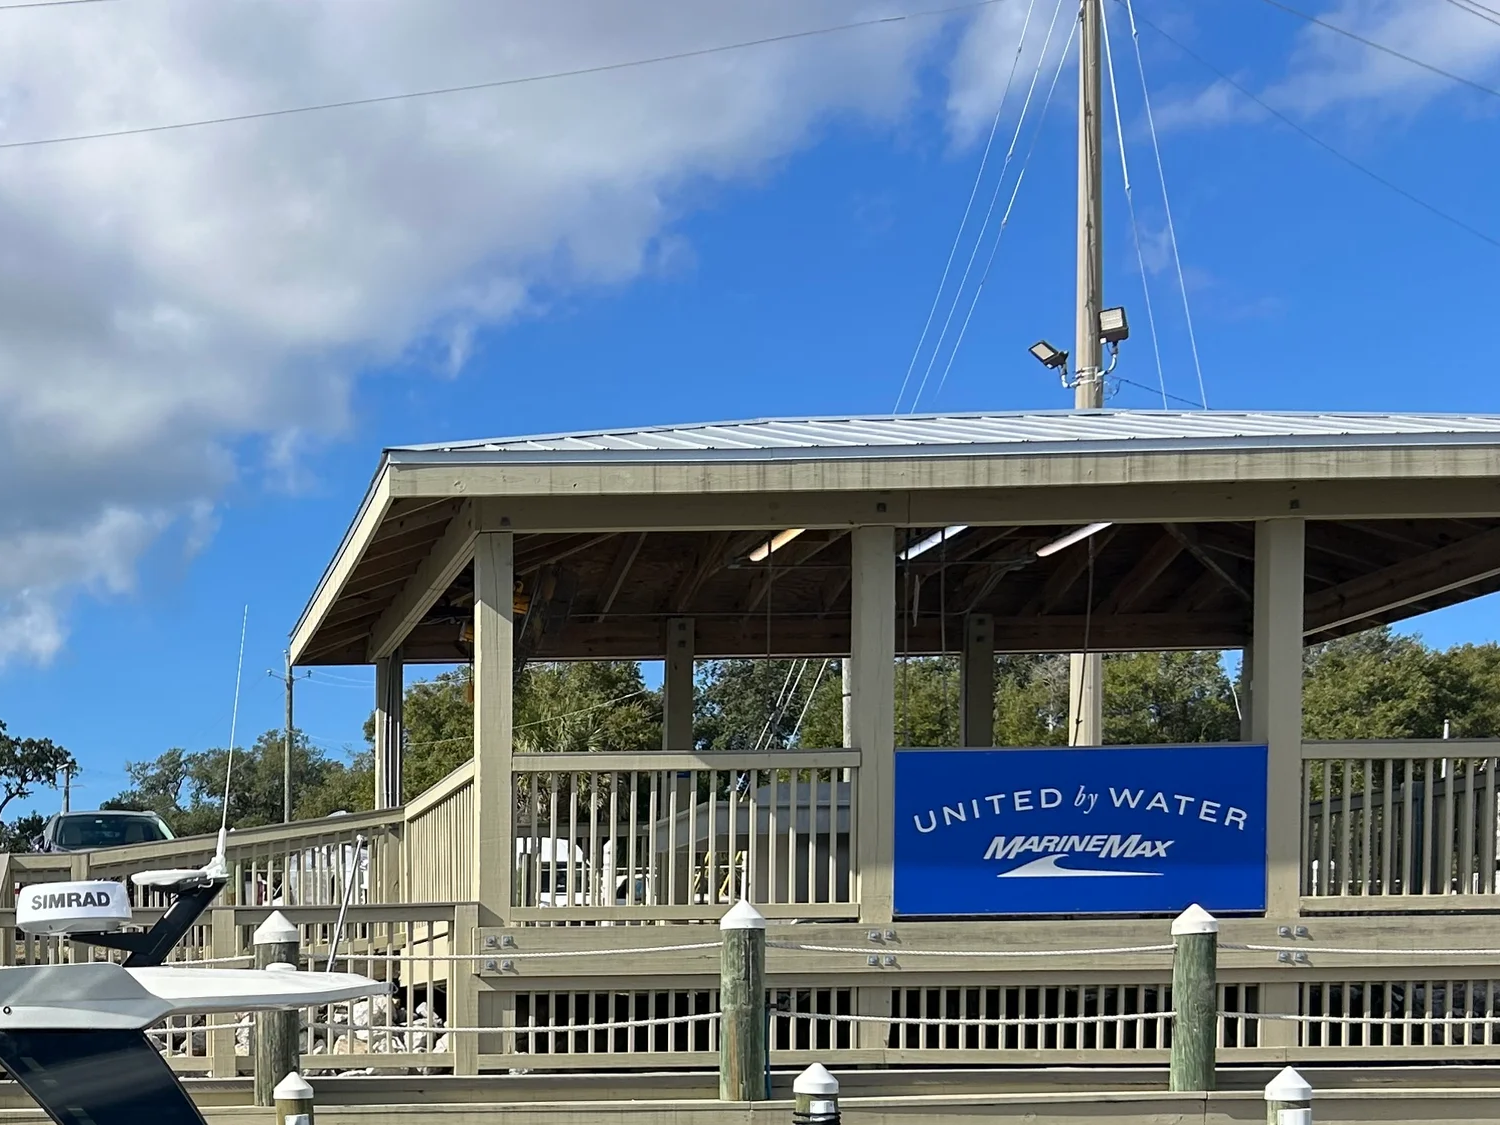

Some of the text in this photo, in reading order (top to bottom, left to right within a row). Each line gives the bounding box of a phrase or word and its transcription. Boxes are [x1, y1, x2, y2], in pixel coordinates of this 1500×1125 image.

[913, 785, 1249, 834] UNITED by WATER
[31, 891, 111, 910] SIMRAD
